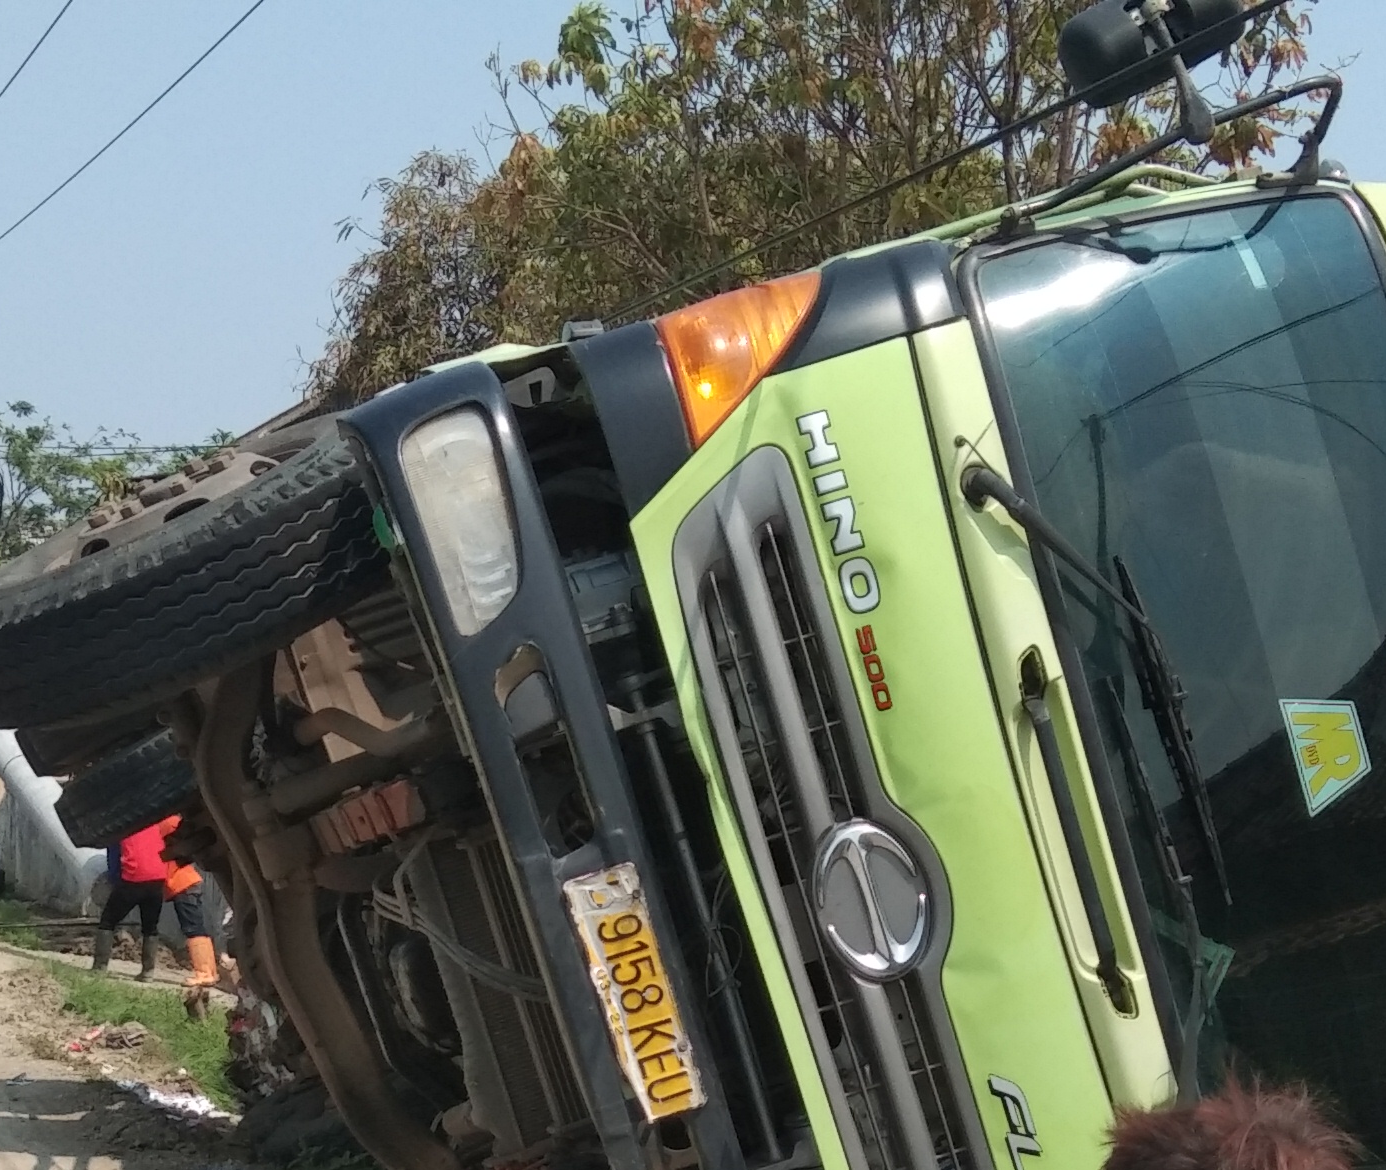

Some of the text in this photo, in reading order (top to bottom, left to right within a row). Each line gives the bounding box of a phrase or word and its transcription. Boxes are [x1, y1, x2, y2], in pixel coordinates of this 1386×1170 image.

[795, 408, 894, 712] HINO 500
[597, 913, 665, 1015] 9158
[628, 1017, 694, 1104] KEU
